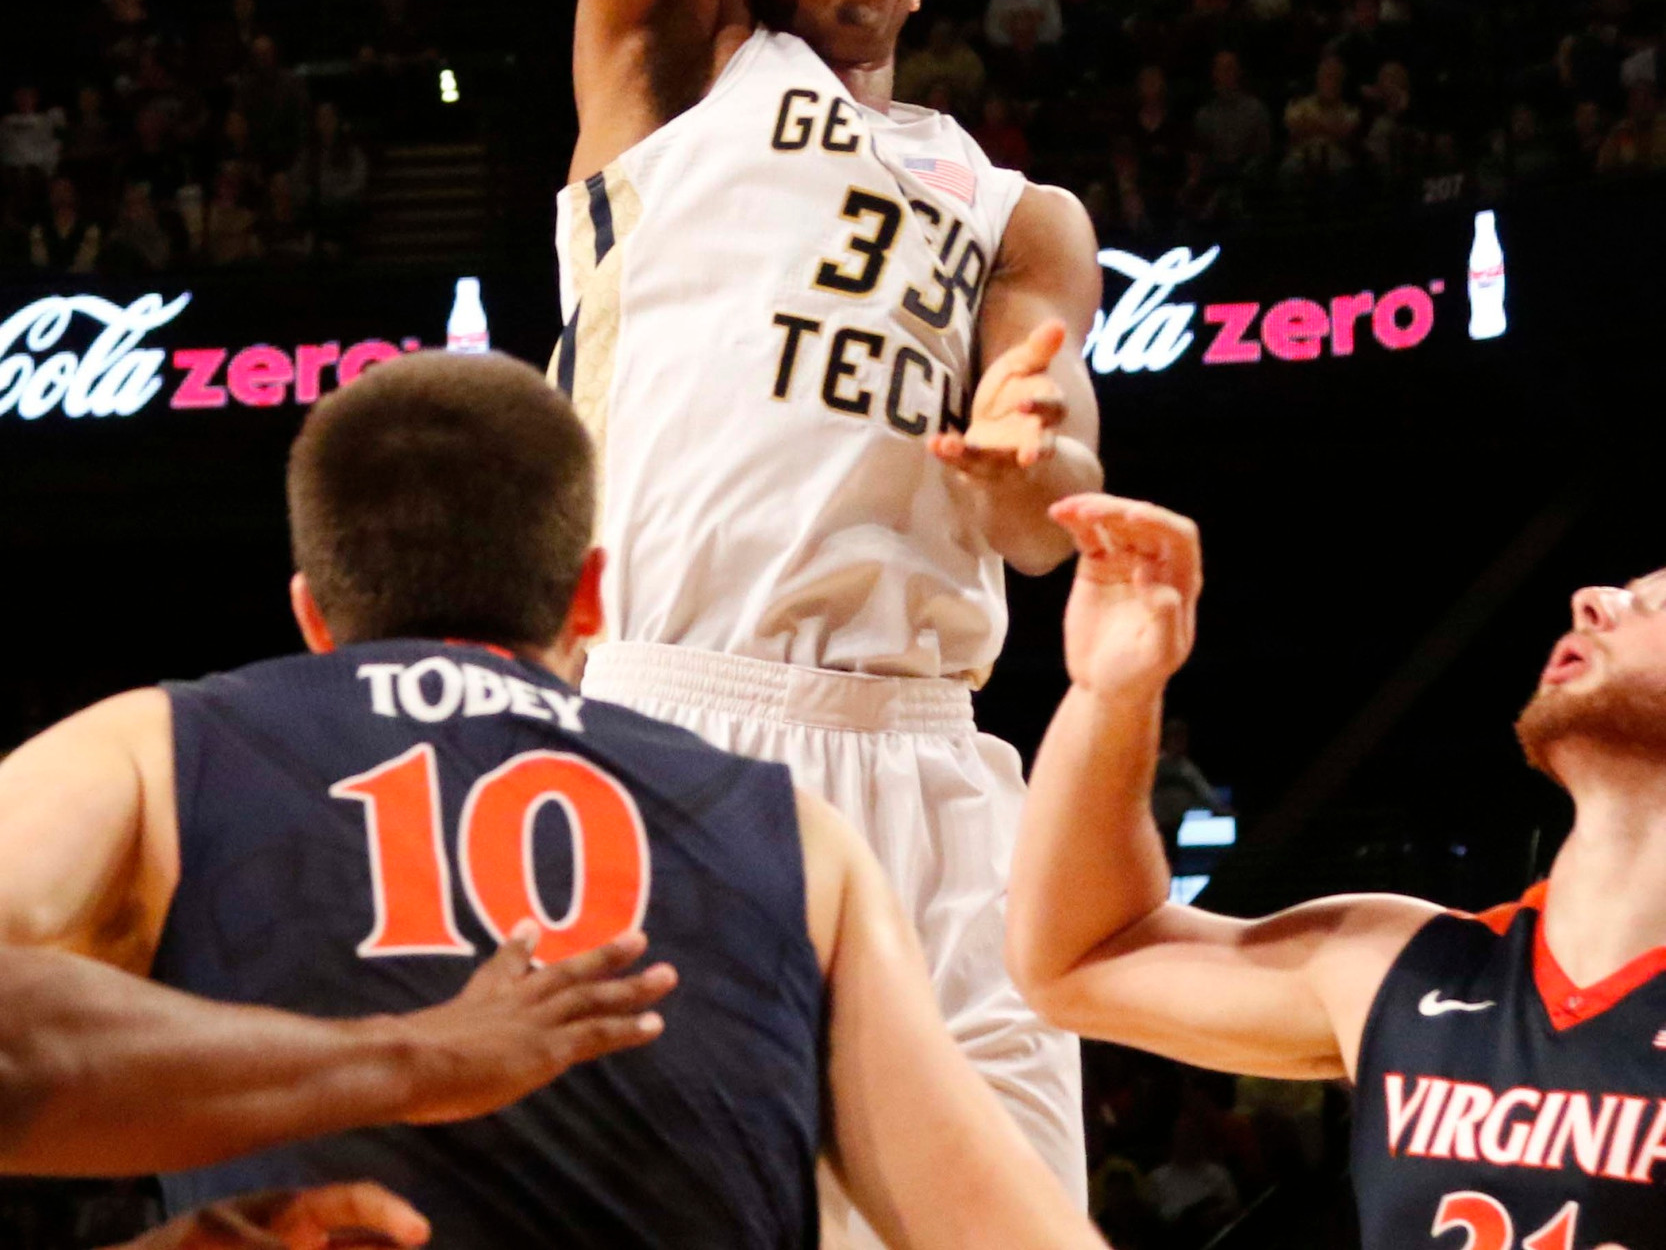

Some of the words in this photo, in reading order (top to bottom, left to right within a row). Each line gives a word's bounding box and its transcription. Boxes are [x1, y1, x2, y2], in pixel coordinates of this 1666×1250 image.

[1202, 285, 1434, 364] zero
[356, 656, 585, 732] TOBEY
[328, 741, 651, 968] 10
